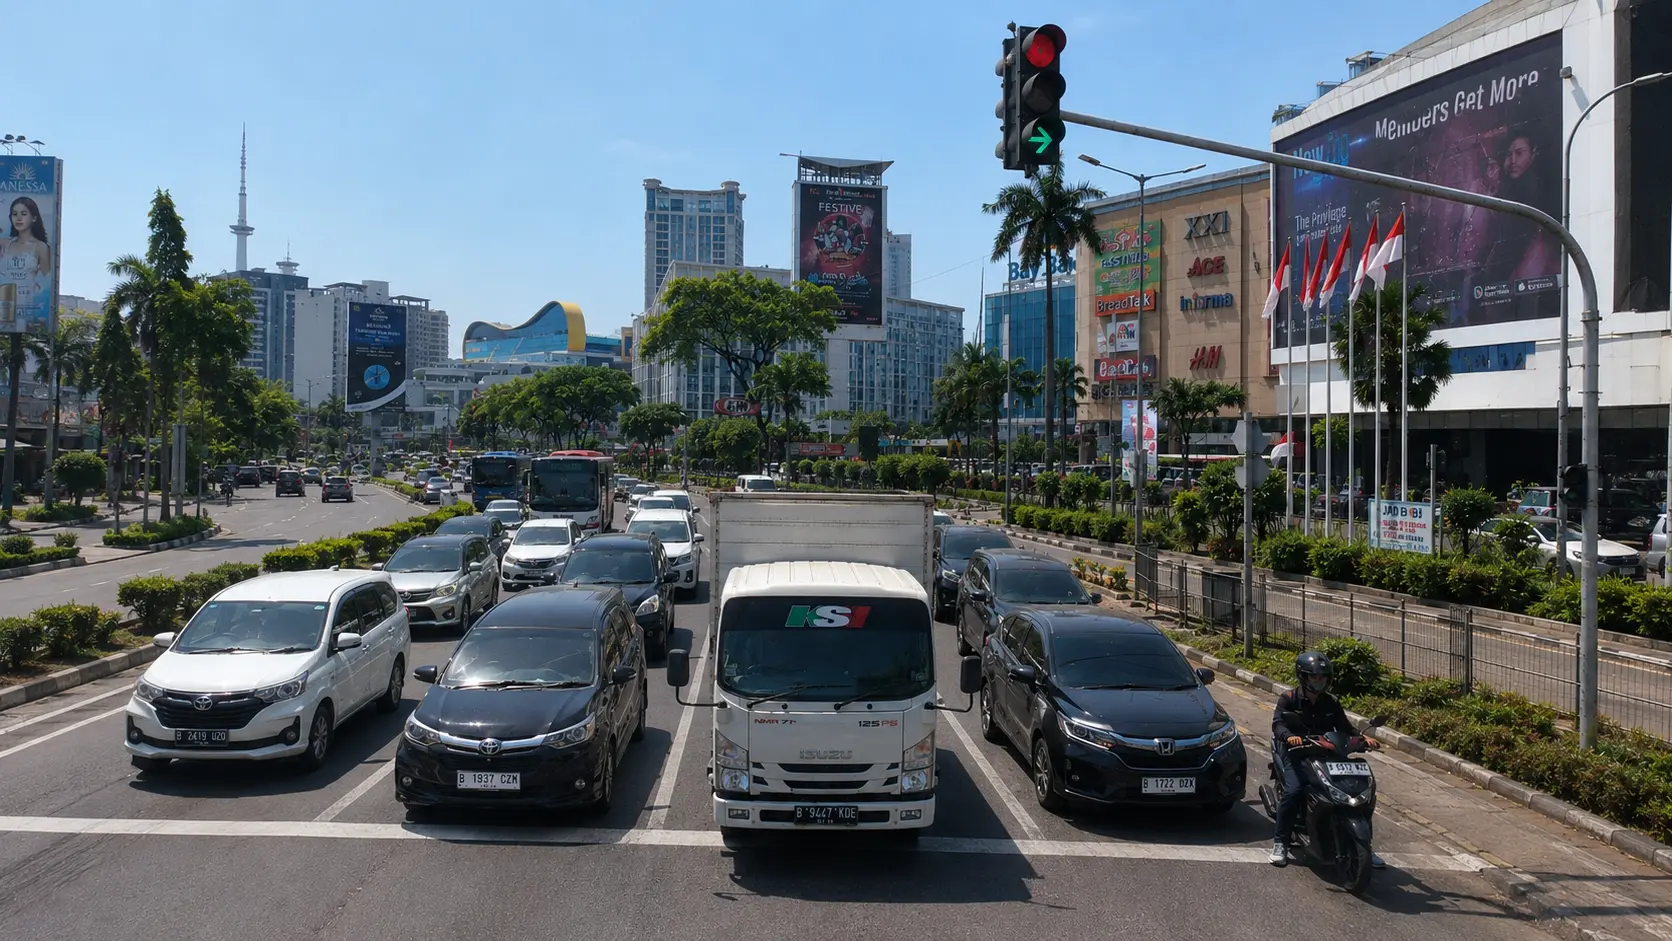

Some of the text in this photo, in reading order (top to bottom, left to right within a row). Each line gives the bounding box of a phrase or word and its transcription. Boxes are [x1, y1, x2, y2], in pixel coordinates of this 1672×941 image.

[1454, 84, 1484, 116] Get
[1490, 70, 1539, 107] More
[0, 181, 48, 192] ANESSA
[818, 202, 863, 214] FESTIVE
[1183, 211, 1230, 239] XXI
[1295, 214, 1310, 231] The
[1187, 255, 1225, 278] ACE
[1097, 293, 1151, 312] BreadTak
[799, 750, 853, 760] ISUZU
[459, 773, 465, 784] B
[473, 773, 495, 784] 1937
[1143, 778, 1149, 789] B
[1155, 778, 1175, 789] 1722
[796, 807, 803, 818] B
